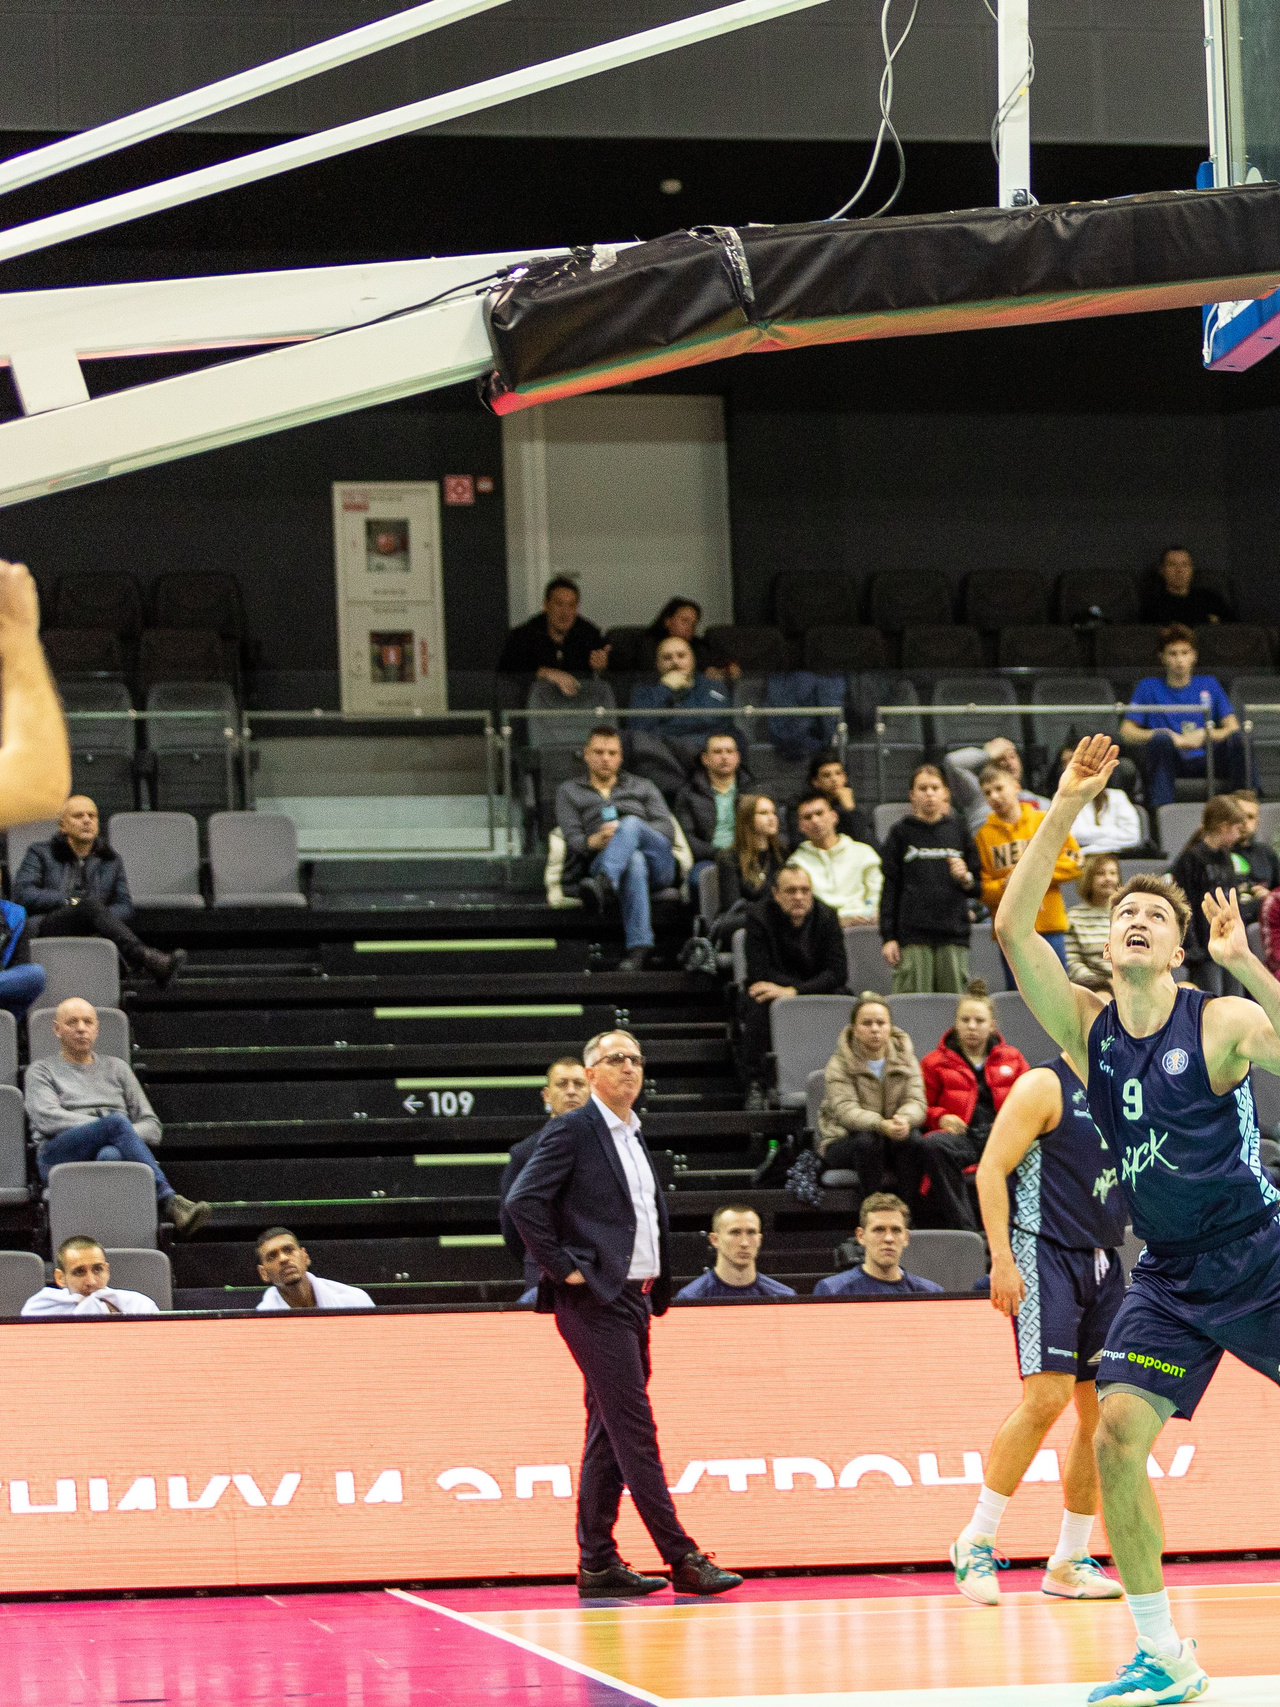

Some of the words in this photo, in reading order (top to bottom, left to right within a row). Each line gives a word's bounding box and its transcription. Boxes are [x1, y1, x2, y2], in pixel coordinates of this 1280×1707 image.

[991, 839, 1031, 870] NE
[428, 1091, 475, 1116] 109
[1122, 1078, 1144, 1121] 9
[1127, 1351, 1187, 1378] евроопт
